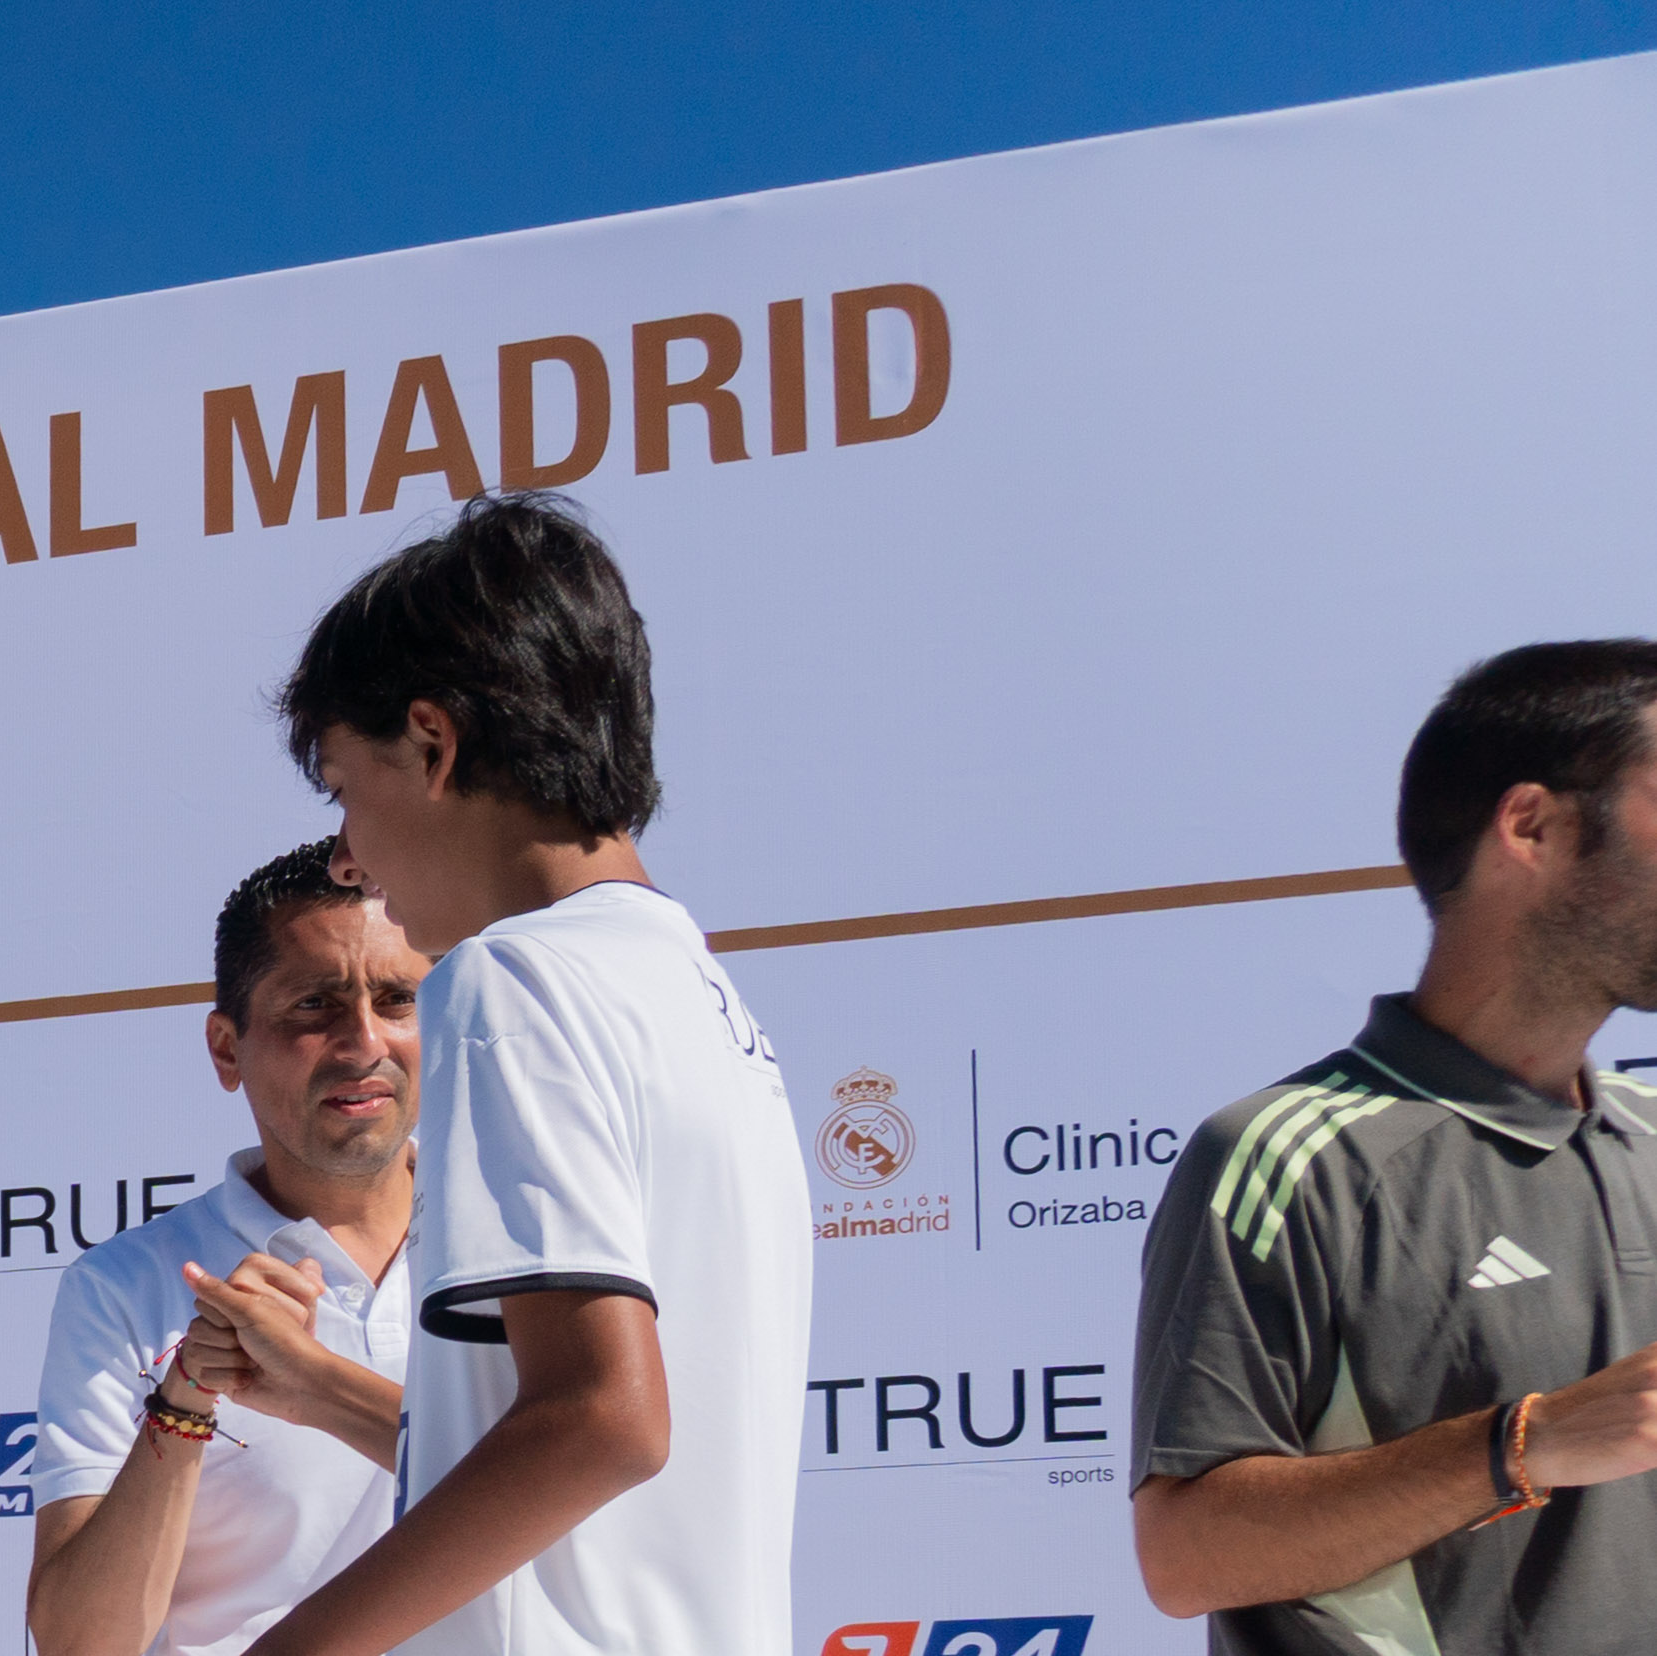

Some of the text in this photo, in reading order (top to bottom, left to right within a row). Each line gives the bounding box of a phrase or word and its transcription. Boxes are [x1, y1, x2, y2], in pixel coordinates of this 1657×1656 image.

[204, 282, 952, 535] MADRID
[1004, 1119, 1180, 1174] Clinic
[823, 1194, 949, 1214] NDACIÓN
[1009, 1196, 1147, 1228] Orizaba
[813, 1208, 949, 1240] ealmadrid
[807, 1364, 1106, 1454] TRUE
[1048, 1467, 1114, 1487] sports
